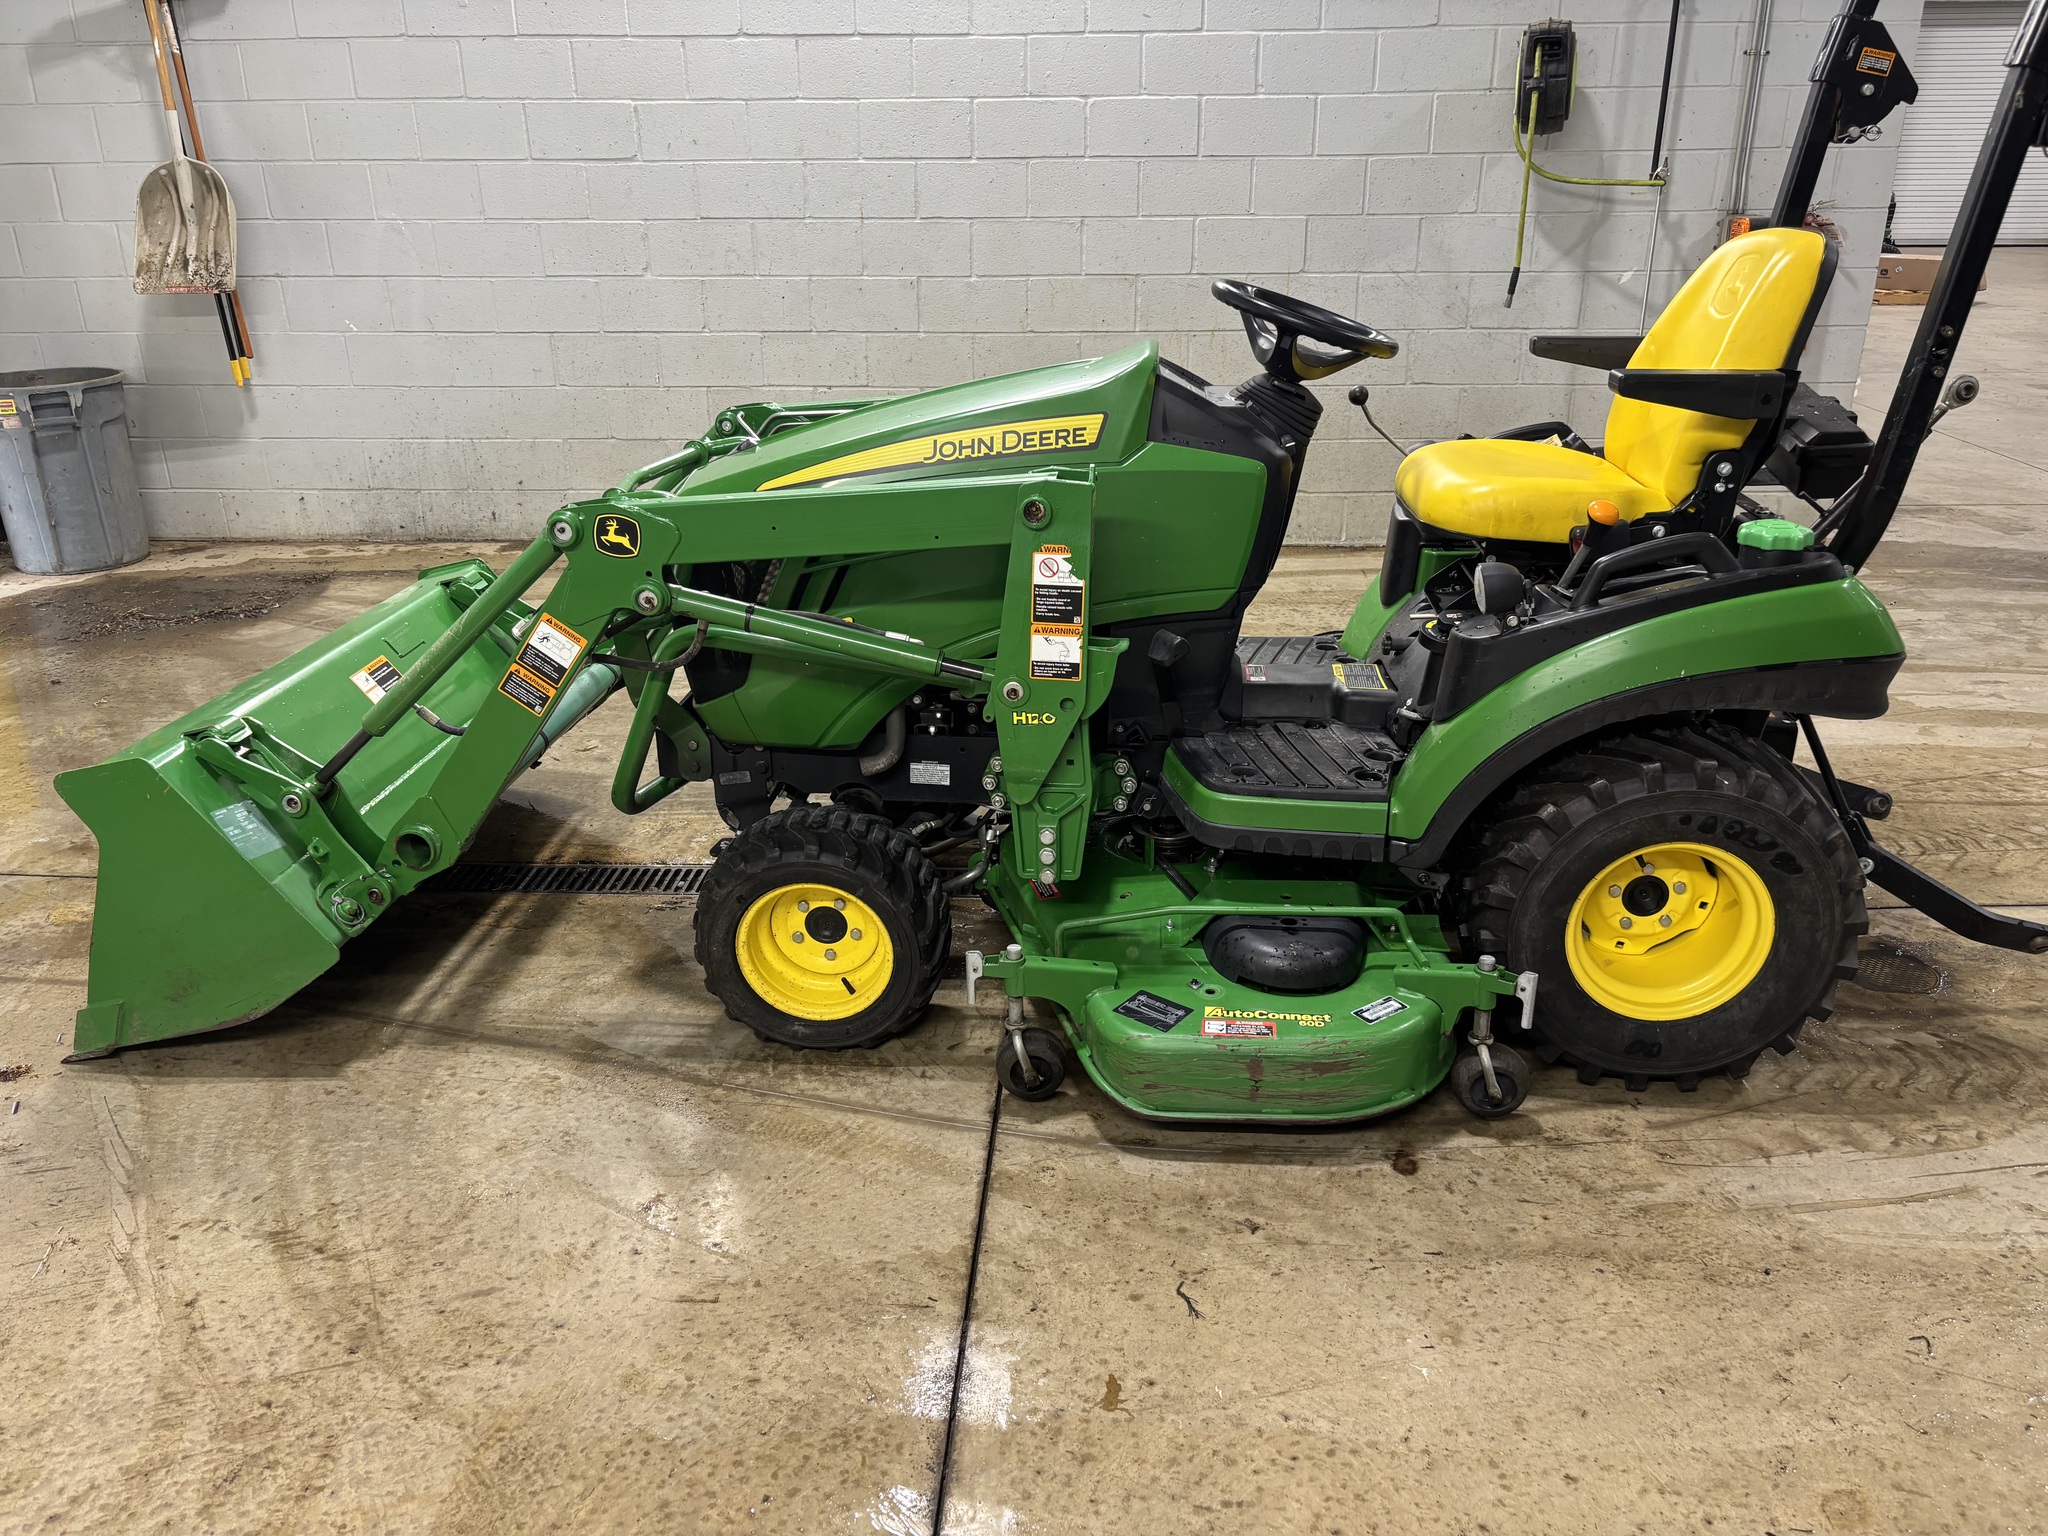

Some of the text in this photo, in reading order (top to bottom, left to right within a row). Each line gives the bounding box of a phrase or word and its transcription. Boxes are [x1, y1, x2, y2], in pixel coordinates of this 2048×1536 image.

[1869, 50, 1893, 59] WARNING
[923, 427, 1087, 461] JOHN DEERE
[1043, 546, 1071, 554] WARN
[553, 621, 581, 644] WARNING
[1041, 627, 1080, 635] WARNING
[523, 672, 550, 694] WARNING
[1205, 1006, 1332, 1022] AutoConnect
[1298, 1020, 1325, 1028] 60D
